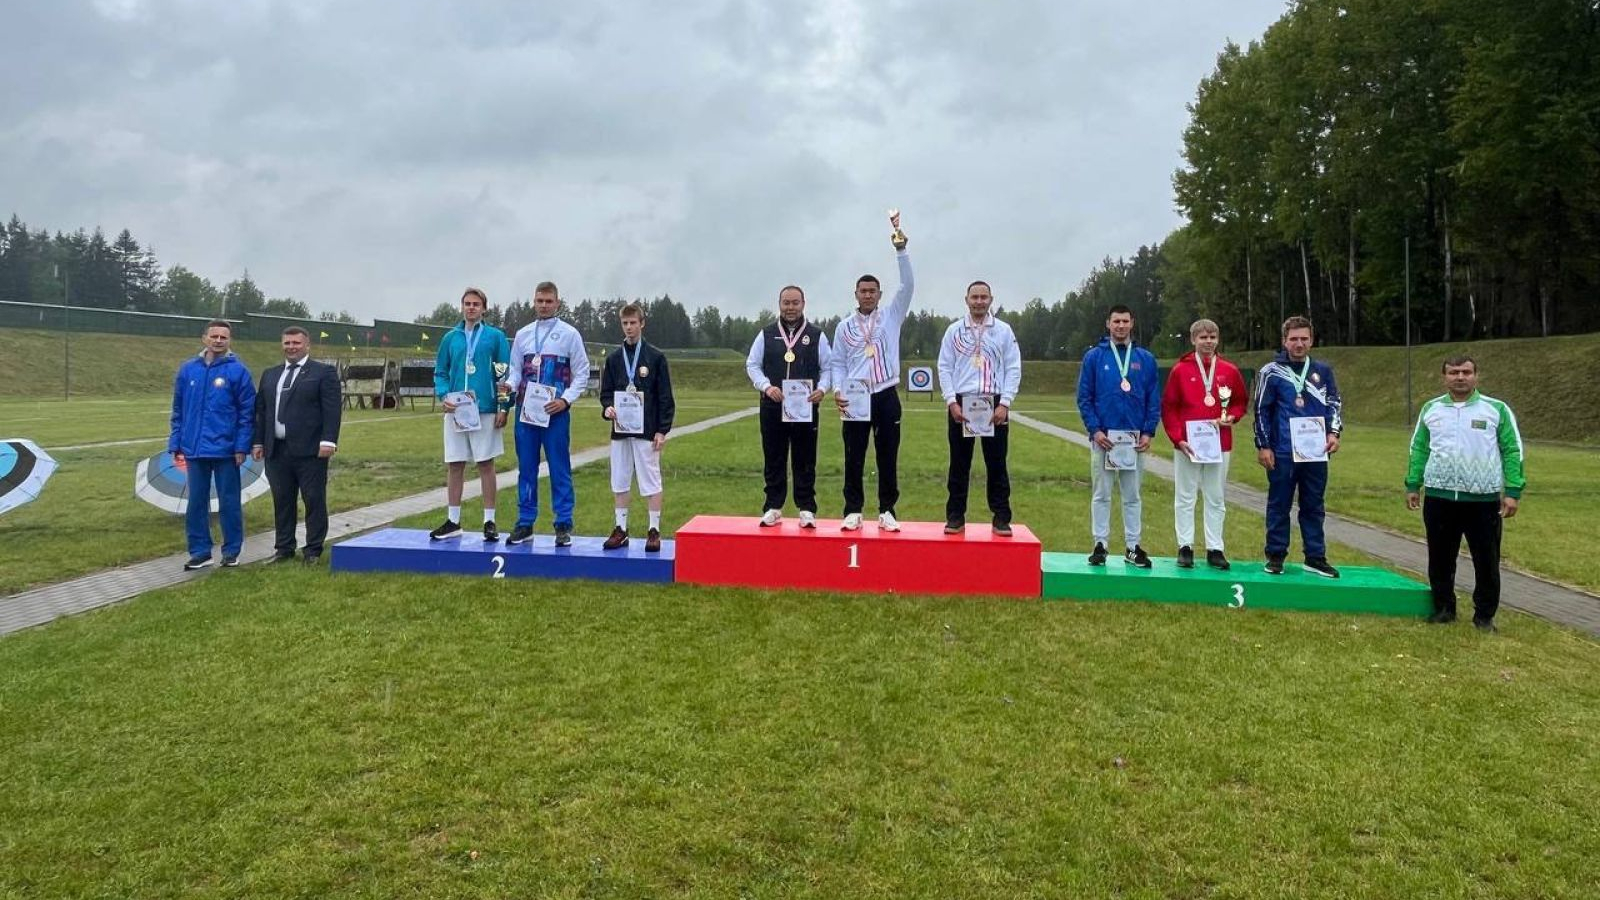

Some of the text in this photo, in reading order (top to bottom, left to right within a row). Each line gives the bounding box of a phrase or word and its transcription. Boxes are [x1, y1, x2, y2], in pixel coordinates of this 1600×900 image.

[491, 555, 506, 578] 2
[847, 544, 860, 568] 1
[1228, 583, 1245, 608] 3
